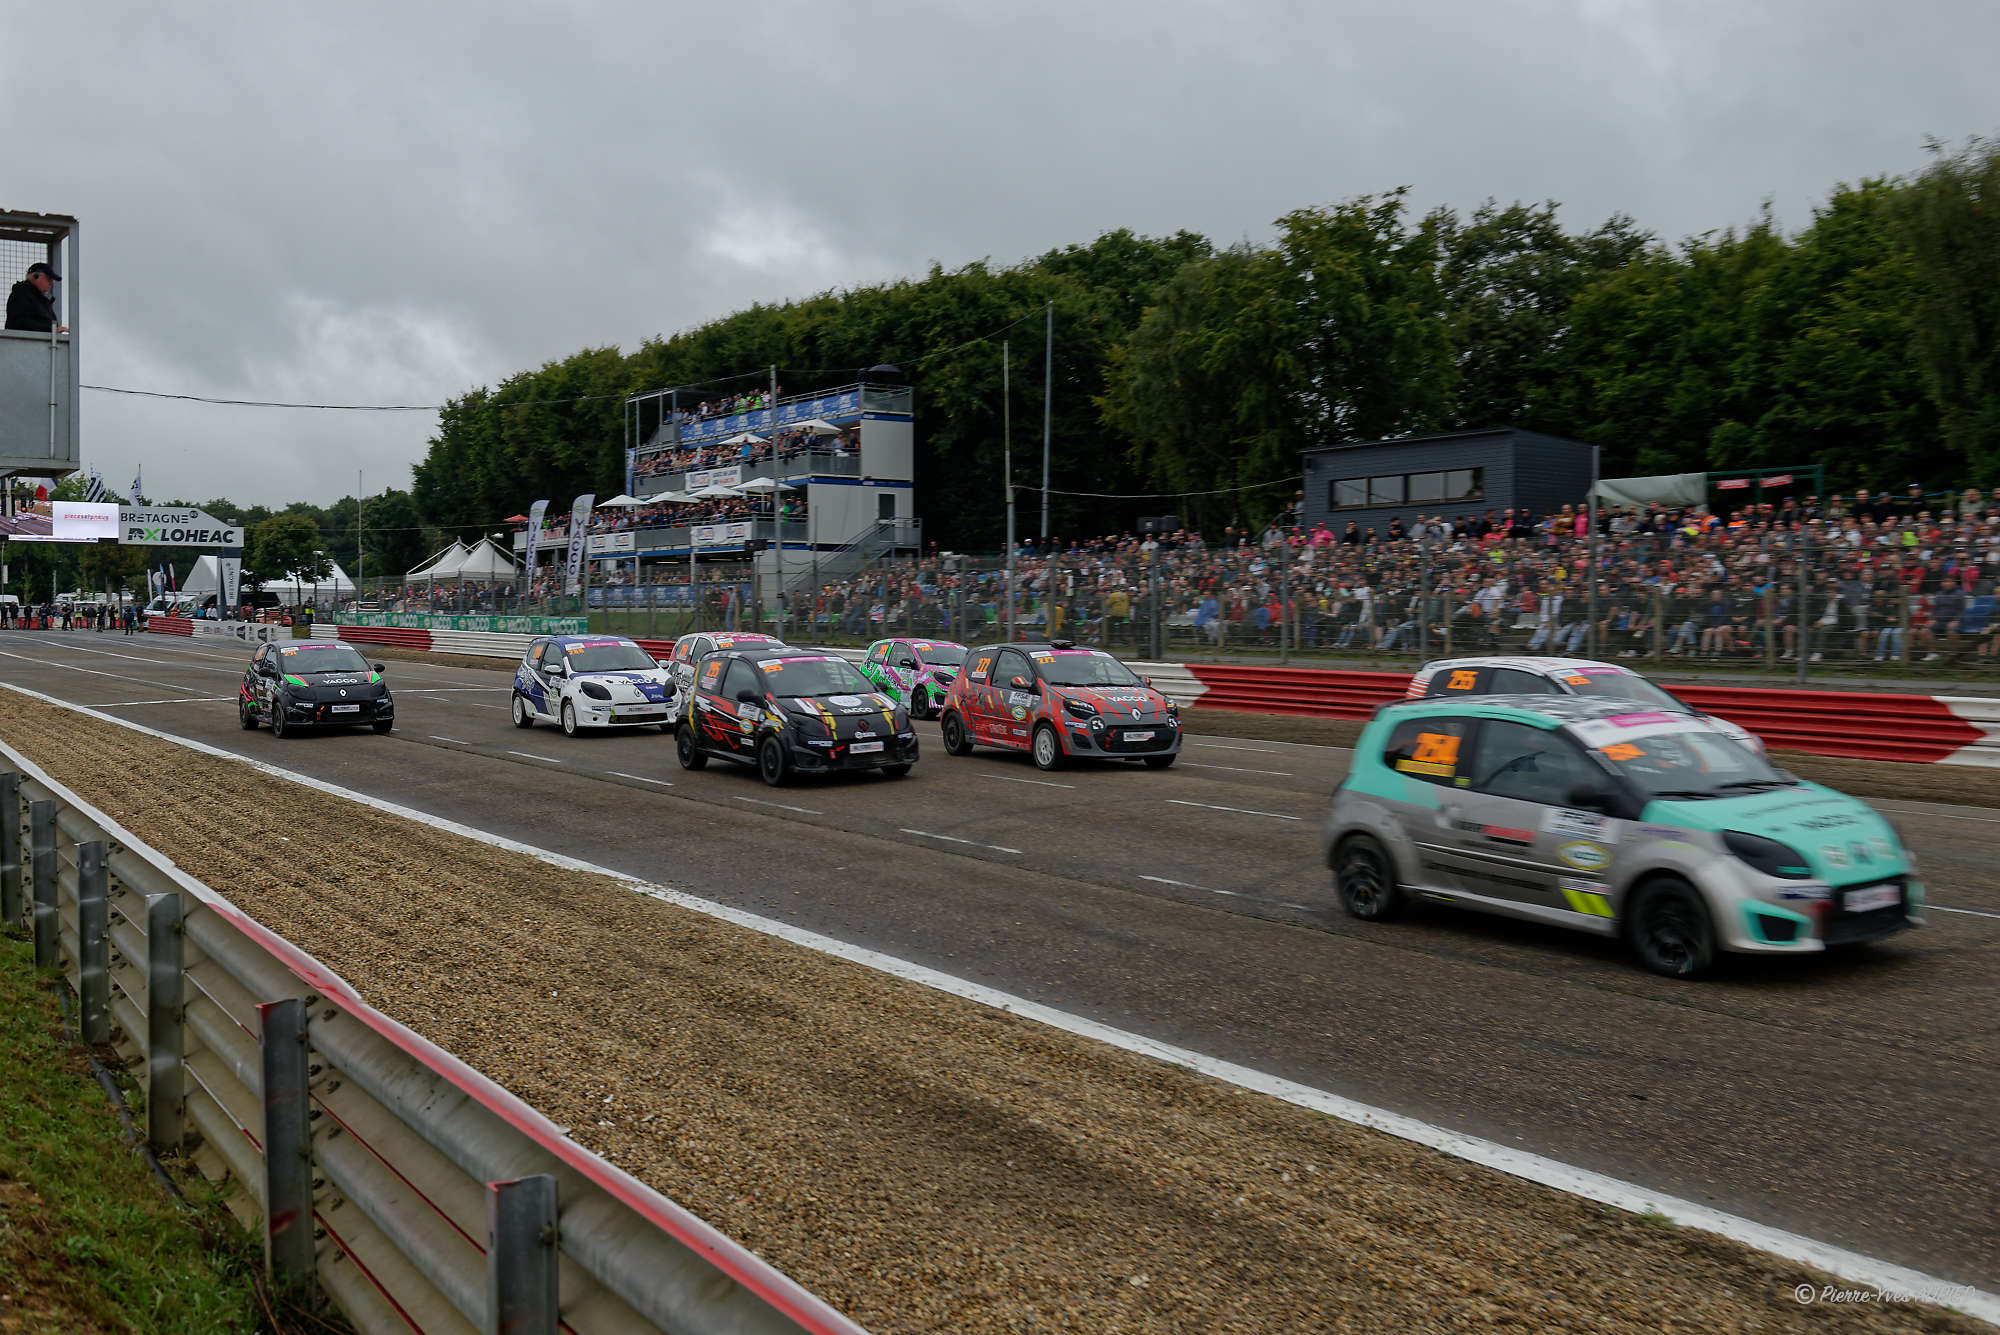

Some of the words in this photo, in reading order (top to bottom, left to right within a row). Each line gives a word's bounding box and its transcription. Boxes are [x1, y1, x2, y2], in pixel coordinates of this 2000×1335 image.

[120, 512, 189, 523] BRETAGNE
[568, 518, 584, 576] YACCO
[975, 658, 991, 673] 272
[1036, 656, 1057, 664] 272
